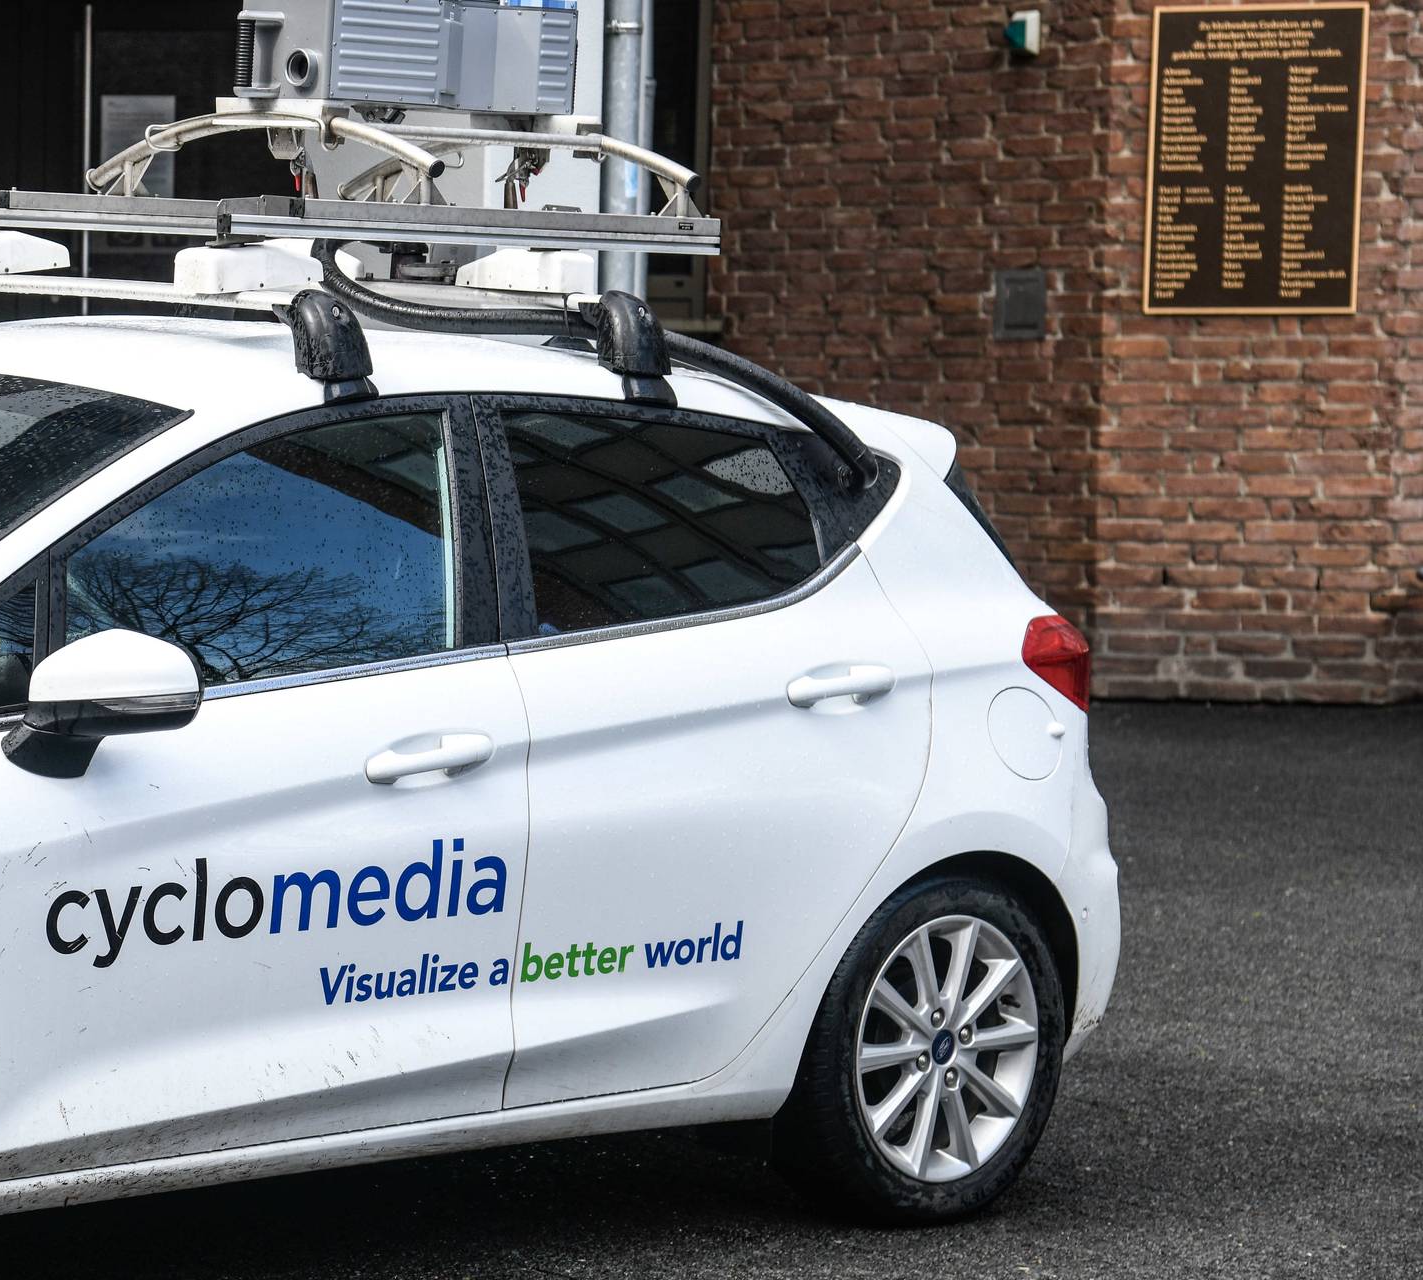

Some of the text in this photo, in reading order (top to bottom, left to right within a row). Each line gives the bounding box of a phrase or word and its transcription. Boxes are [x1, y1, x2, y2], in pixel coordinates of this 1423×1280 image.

[46, 837, 507, 968] cyclomedia
[319, 920, 744, 1006] Visualize a better world
